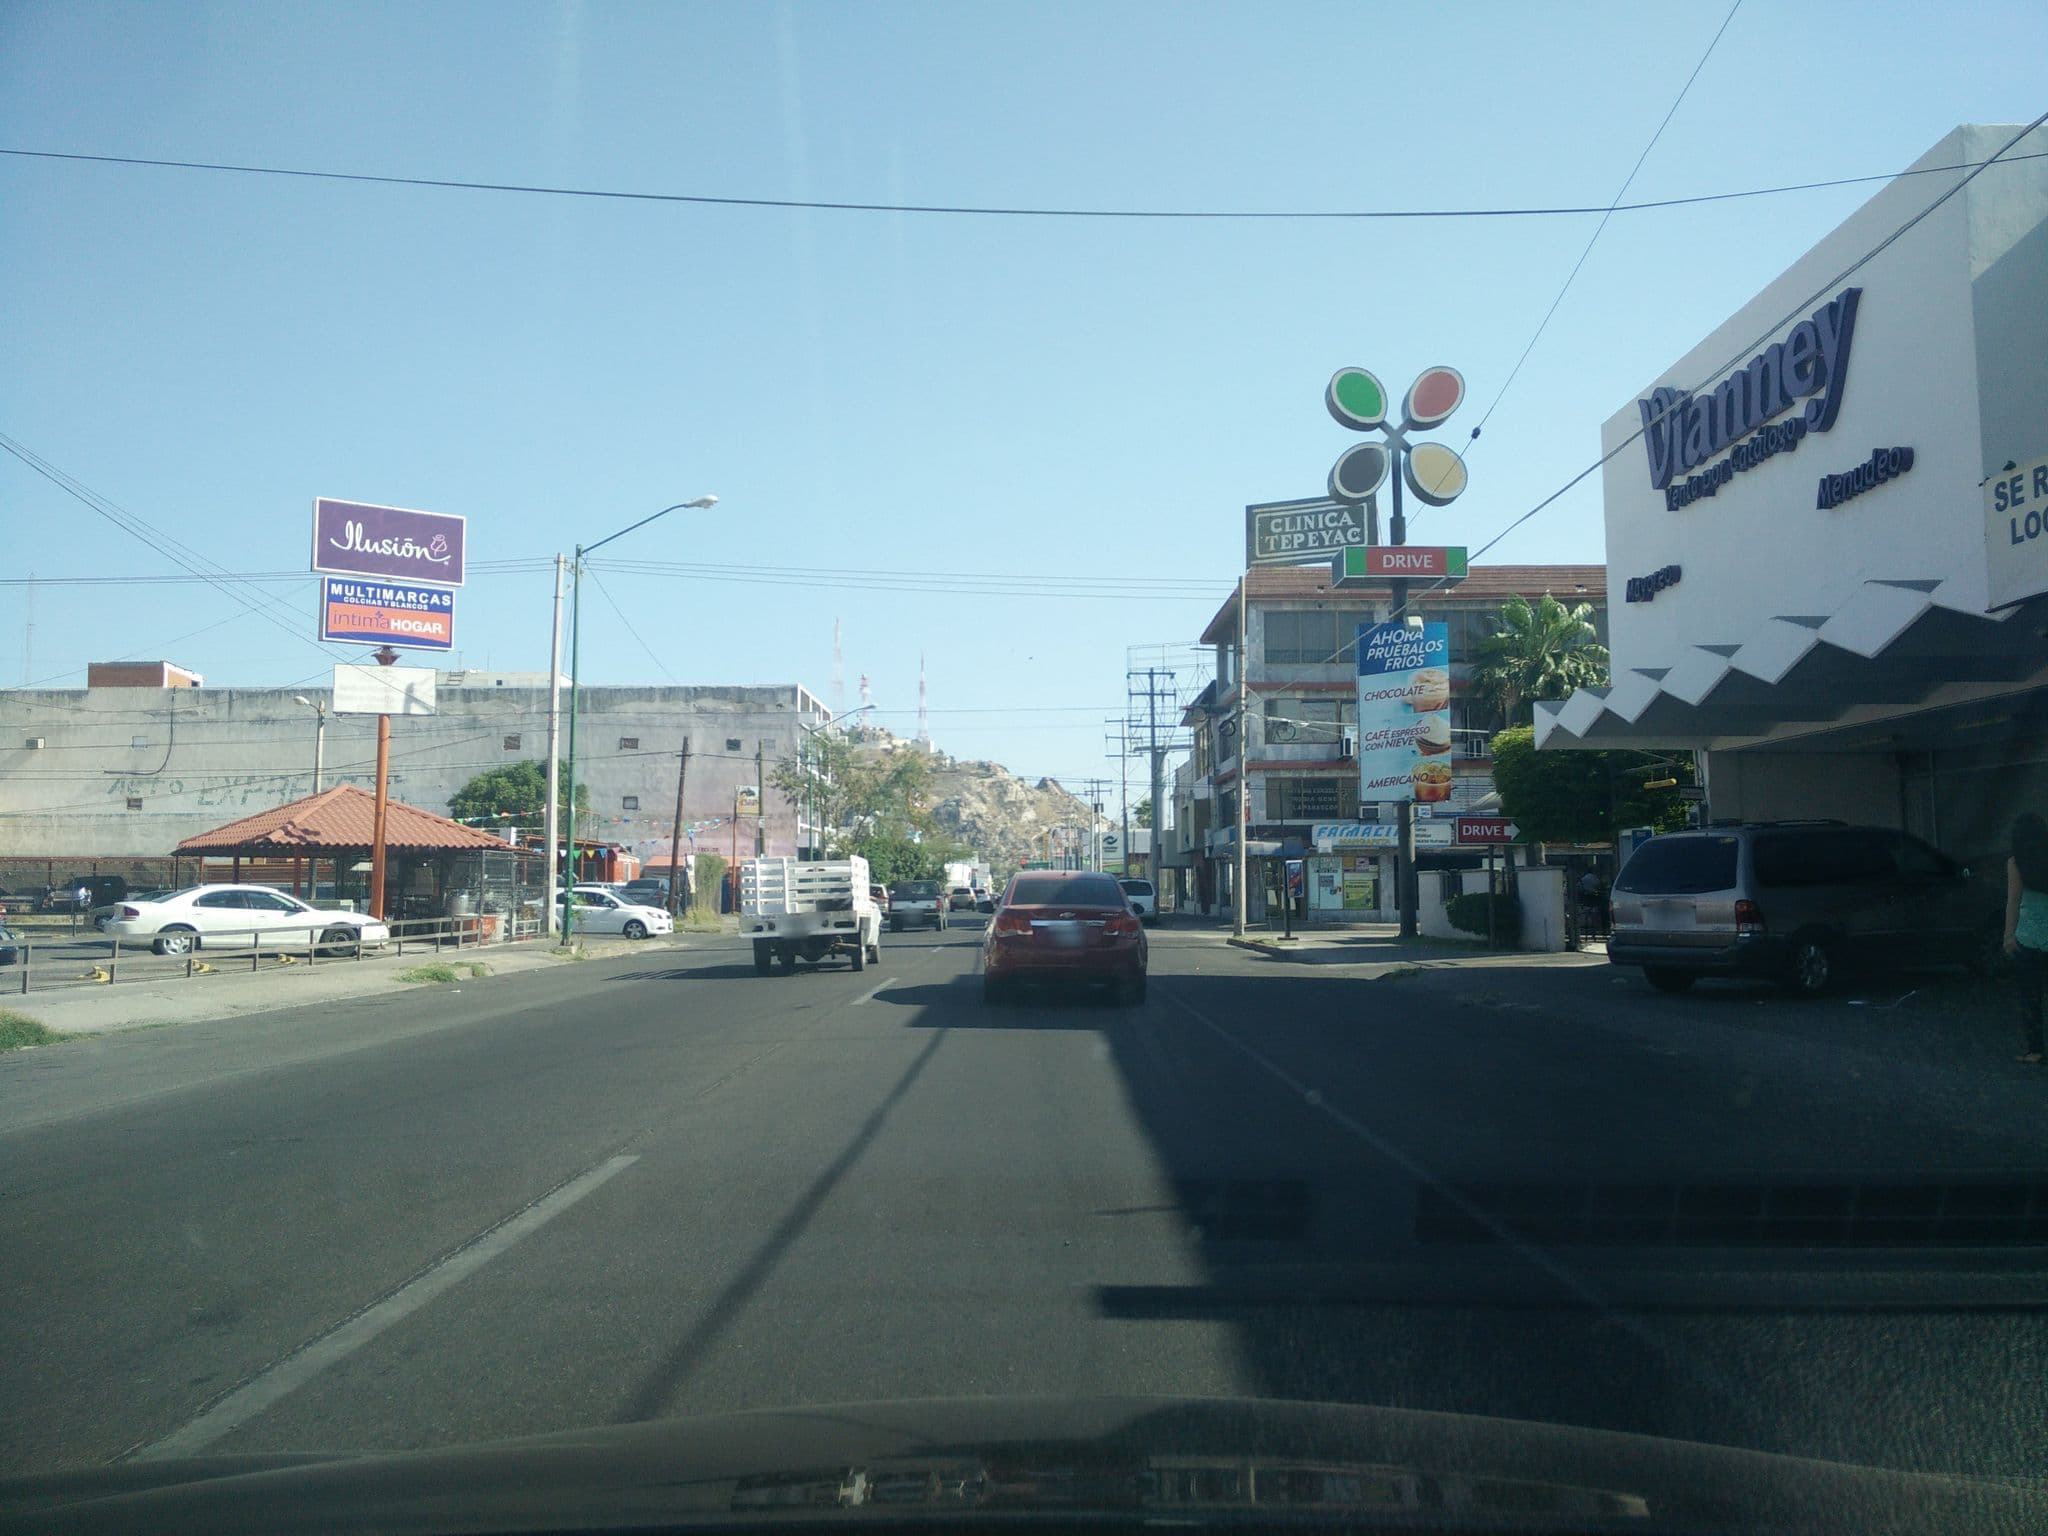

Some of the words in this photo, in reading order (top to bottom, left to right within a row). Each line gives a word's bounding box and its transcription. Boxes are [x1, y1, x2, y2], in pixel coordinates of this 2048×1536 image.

[1638, 287, 1863, 490] Vianney
[1702, 458, 1733, 497] por
[1816, 446, 1914, 510] Menudeo
[1994, 473, 2025, 512] SE
[1270, 511, 1355, 534] CLINICA
[330, 519, 452, 563] Ilusión
[1265, 526, 1362, 551] TEPEYAC
[1382, 554, 1434, 569] DRIVE
[330, 583, 452, 607] MULTIMARCAS
[343, 596, 382, 607] COLCHAS
[390, 601, 428, 611] BLANCOS
[391, 615, 443, 634] HOGAR
[1370, 628, 1424, 647] AHORA
[1384, 654, 1425, 672] FRIOS
[1364, 685, 1425, 702] CHOCOLATE
[1365, 726, 1390, 742] CAFÉ
[1391, 726, 1431, 740] ESPRESSO
[1365, 741, 1385, 752] CON
[1385, 736, 1415, 750] NIEVE
[1367, 772, 1429, 790] AMERICANO
[1462, 824, 1501, 837] DRIVE
